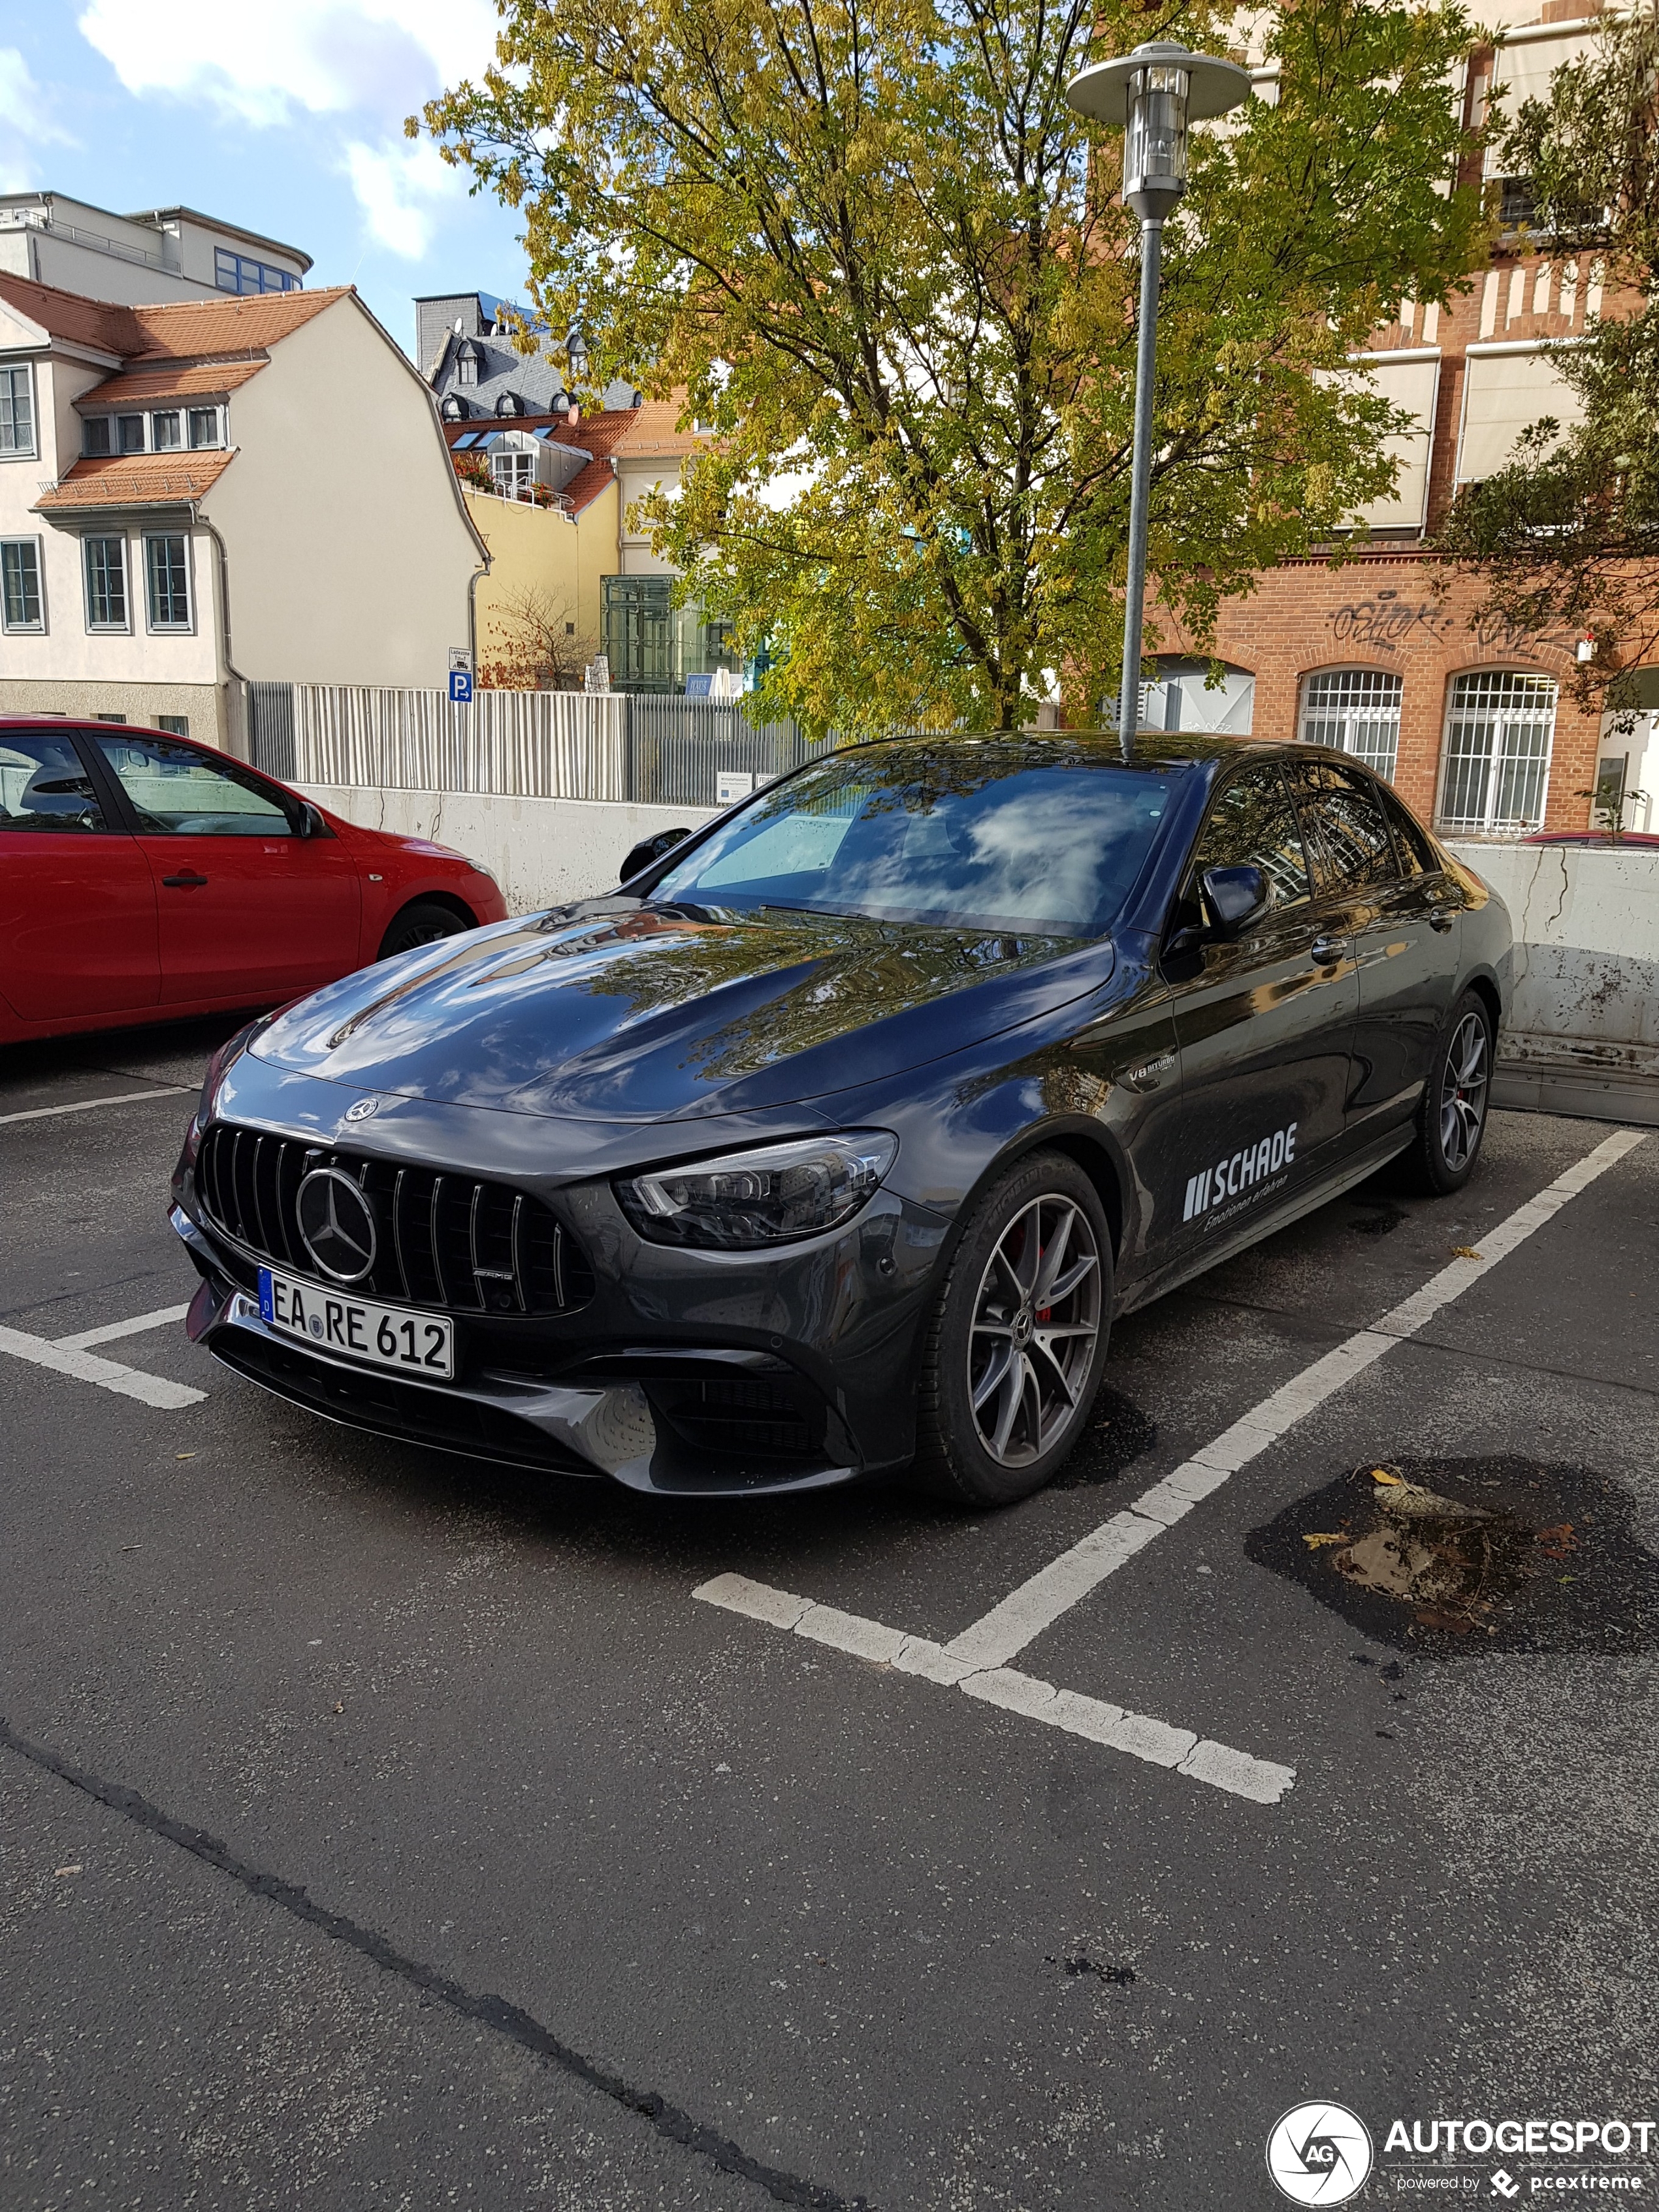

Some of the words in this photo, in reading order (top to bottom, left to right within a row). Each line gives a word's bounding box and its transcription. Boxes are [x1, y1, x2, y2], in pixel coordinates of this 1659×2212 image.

[455, 675, 467, 698] P
[1129, 1067, 1147, 1082] V8
[1147, 1055, 1175, 1072] BITURBO
[1212, 1122, 1297, 1205] SCHADE
[1203, 1196, 1251, 1232] Emotionen
[1252, 1174, 1288, 1203] erfahren
[485, 1272, 513, 1280] AMG
[264, 1300, 270, 1312] D
[272, 1279, 307, 1332] EA
[325, 1300, 368, 1352] RE
[377, 1315, 446, 1370] 612
